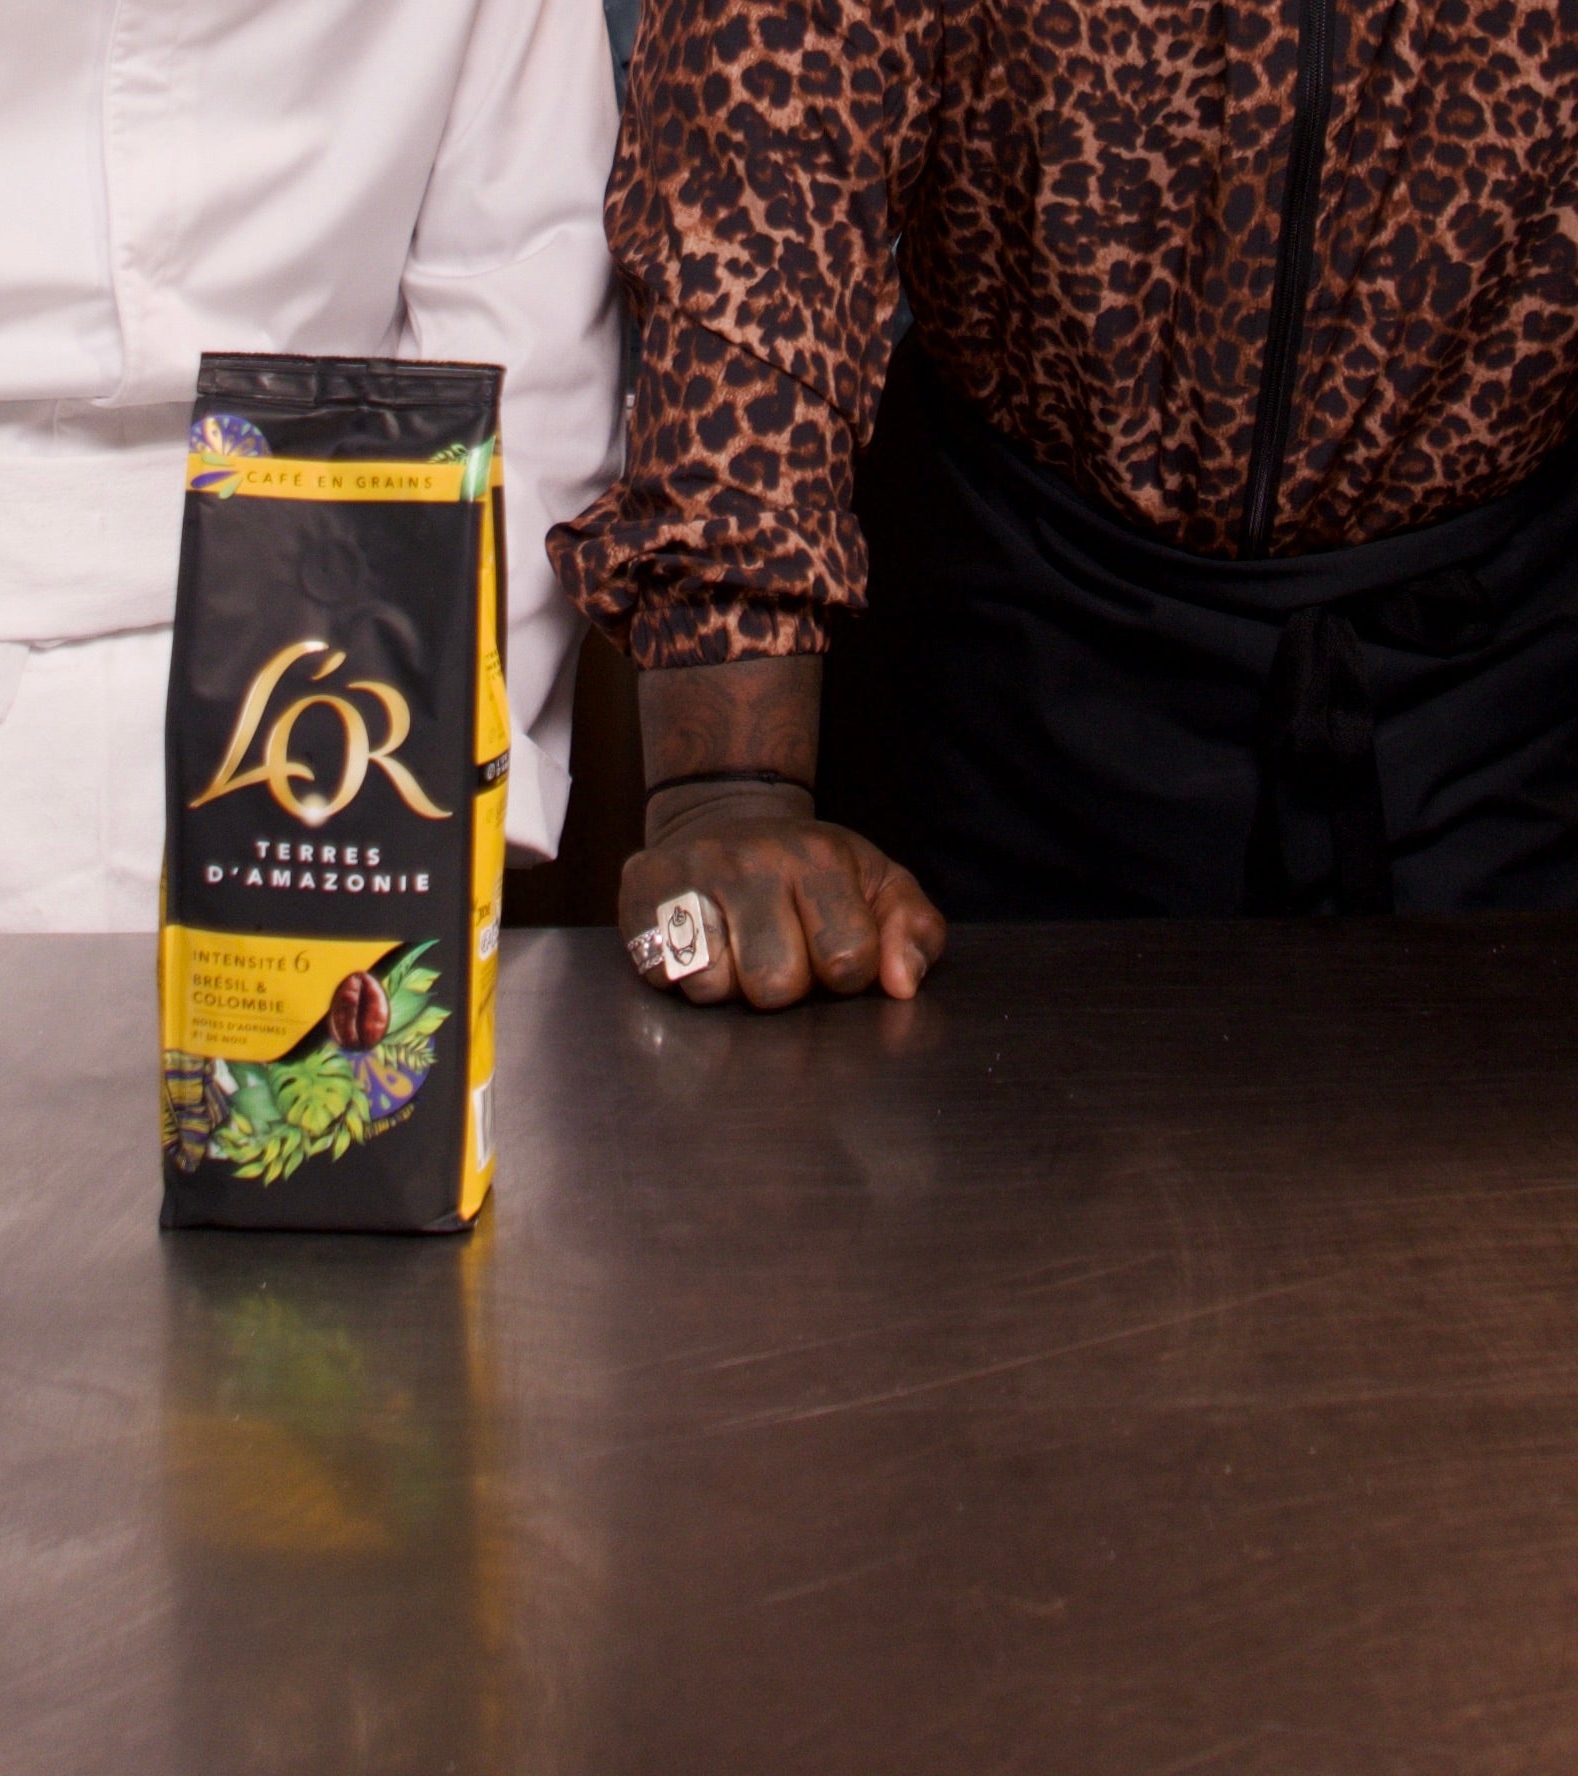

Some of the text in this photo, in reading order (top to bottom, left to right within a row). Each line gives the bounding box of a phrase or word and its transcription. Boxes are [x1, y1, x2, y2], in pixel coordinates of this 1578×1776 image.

[246, 470, 434, 490] CAFÉ EN GRAINS
[187, 640, 454, 827] L'OR
[256, 840, 382, 866] TERRES
[206, 865, 430, 893] D'AMAZONIE
[192, 949, 311, 974] INTENSITÉ 6
[192, 973, 267, 994] BRÉSIL &
[192, 991, 285, 1013] COLOMBIE
